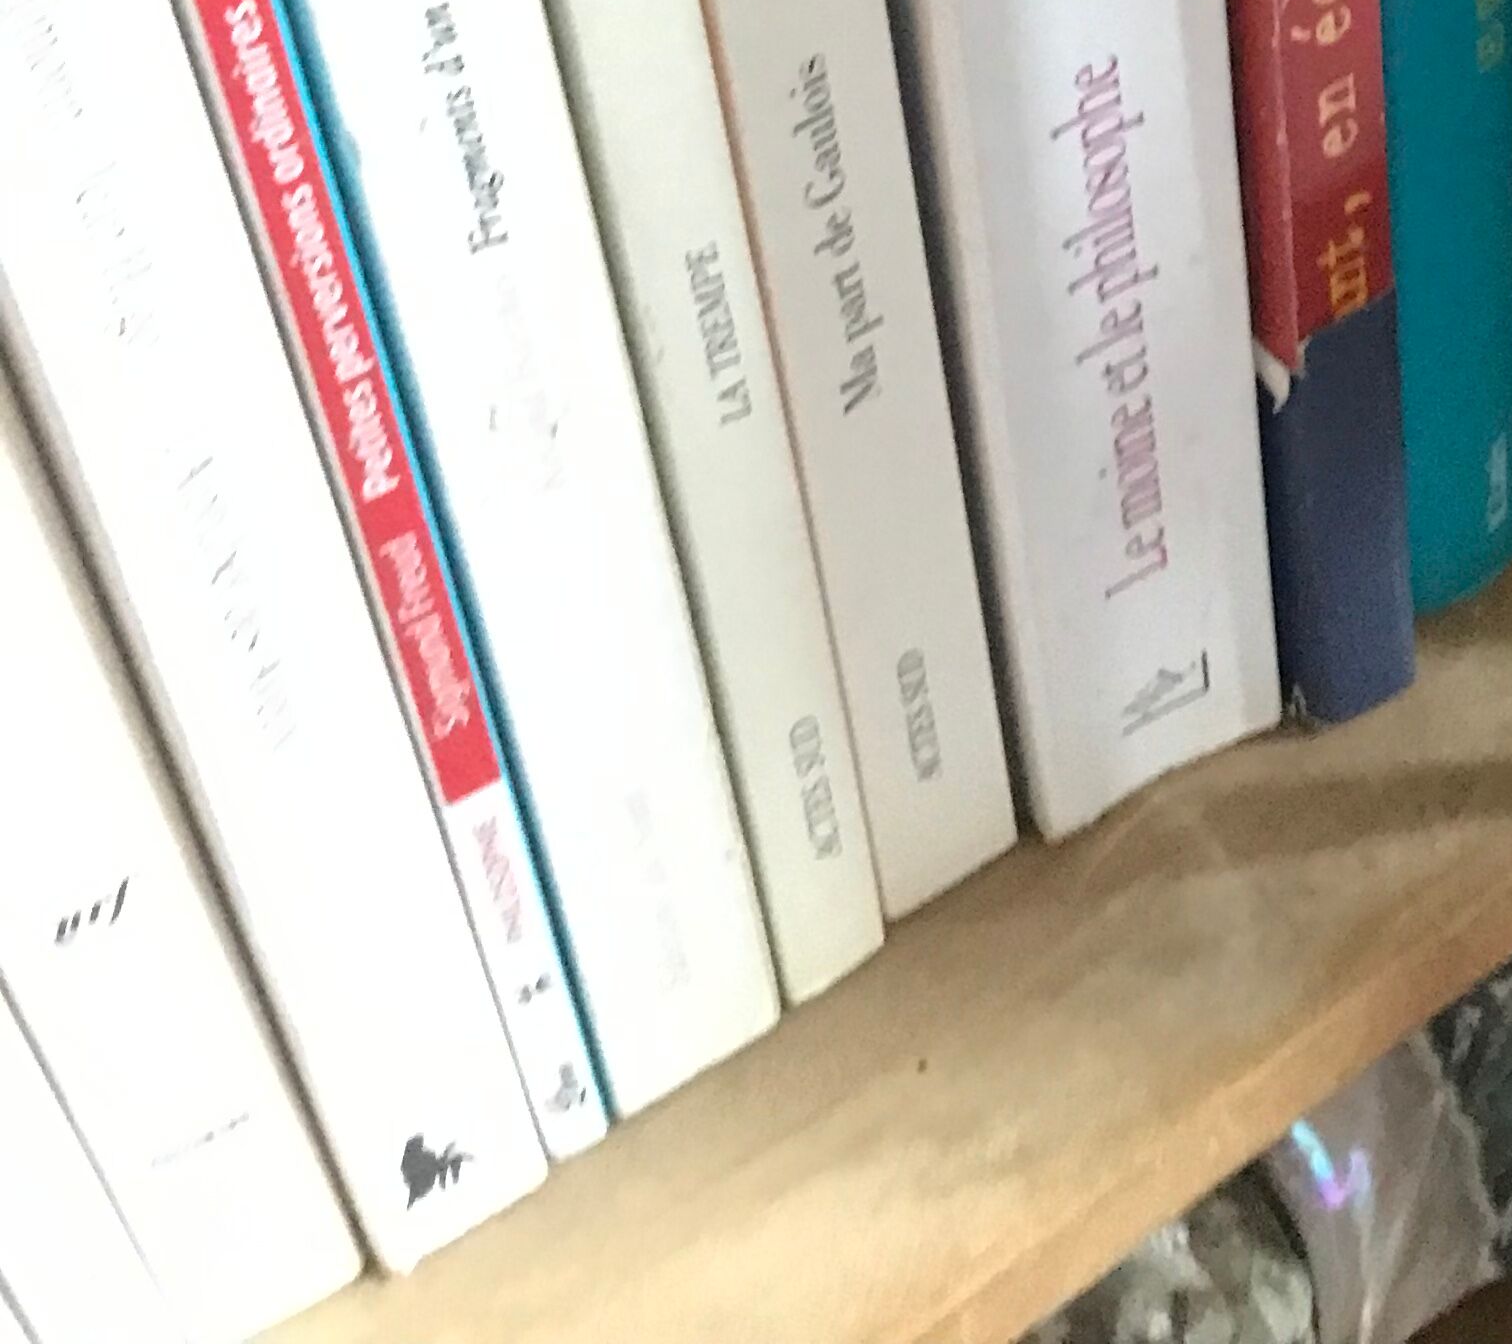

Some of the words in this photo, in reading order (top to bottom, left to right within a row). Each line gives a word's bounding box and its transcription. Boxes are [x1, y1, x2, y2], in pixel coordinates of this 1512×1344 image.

[422, 2, 465, 76] d'un
[791, 55, 847, 206] Gaulois
[1319, 74, 1357, 158] en
[446, 85, 508, 254] Fragments
[1050, 54, 1160, 303] philosophe
[815, 210, 854, 258] de
[280, 183, 373, 382] perversions
[685, 241, 741, 380] TREMPE
[833, 262, 883, 343] part
[1076, 301, 1143, 364] le
[717, 378, 752, 425] LA
[840, 345, 882, 414] Ma
[341, 378, 400, 500] Petites
[1099, 397, 1162, 529] moine
[1105, 526, 1168, 598] Le
